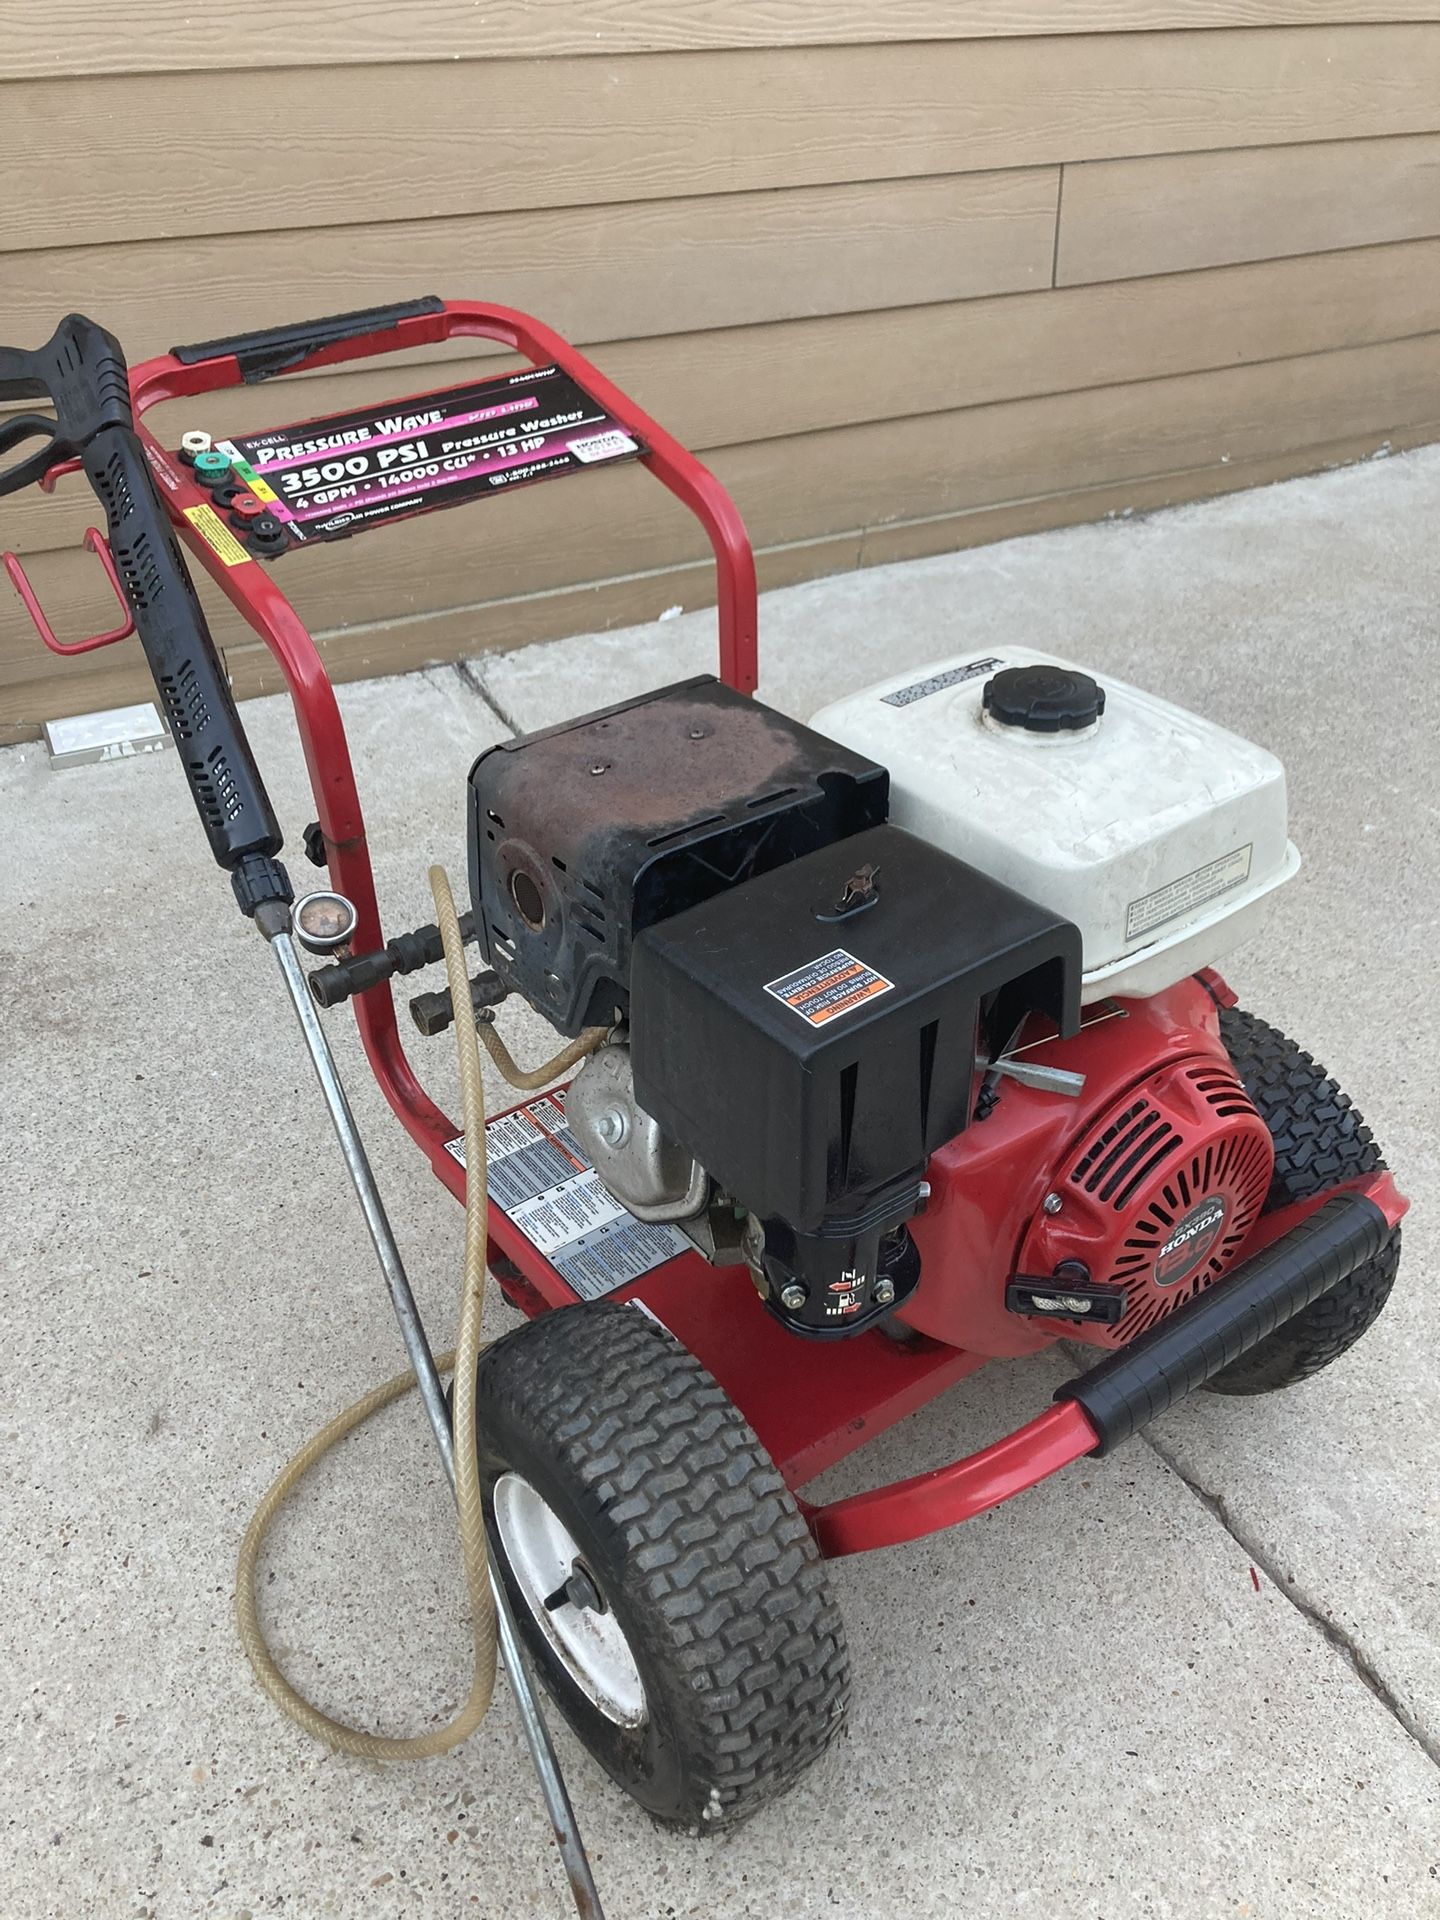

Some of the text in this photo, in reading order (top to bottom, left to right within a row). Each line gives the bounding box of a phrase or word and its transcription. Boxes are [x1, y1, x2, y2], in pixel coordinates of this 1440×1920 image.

[246, 433, 286, 449] EX-CELL
[256, 410, 443, 465] PRESSURE WAVE
[441, 411, 584, 453] Pressure Washer
[281, 440, 429, 493] 3500 PSI
[296, 497, 309, 508] 4
[313, 485, 357, 504] GPM
[378, 463, 440, 488] 14000
[497, 443, 518, 458] 13
[521, 436, 545, 453] HP
[391, 497, 423, 511] COMPANY
[816, 960, 855, 981] SUPERFICIE
[863, 975, 878, 985] HOT
[794, 970, 850, 1001] ADVERTENCIA
[823, 988, 838, 998] NOT
[837, 983, 848, 991] DO
[805, 1008, 815, 1016] OF
[814, 999, 830, 1010] RISK
[827, 989, 867, 1014] WARNING
[1159, 1209, 1224, 1258] HONDA
